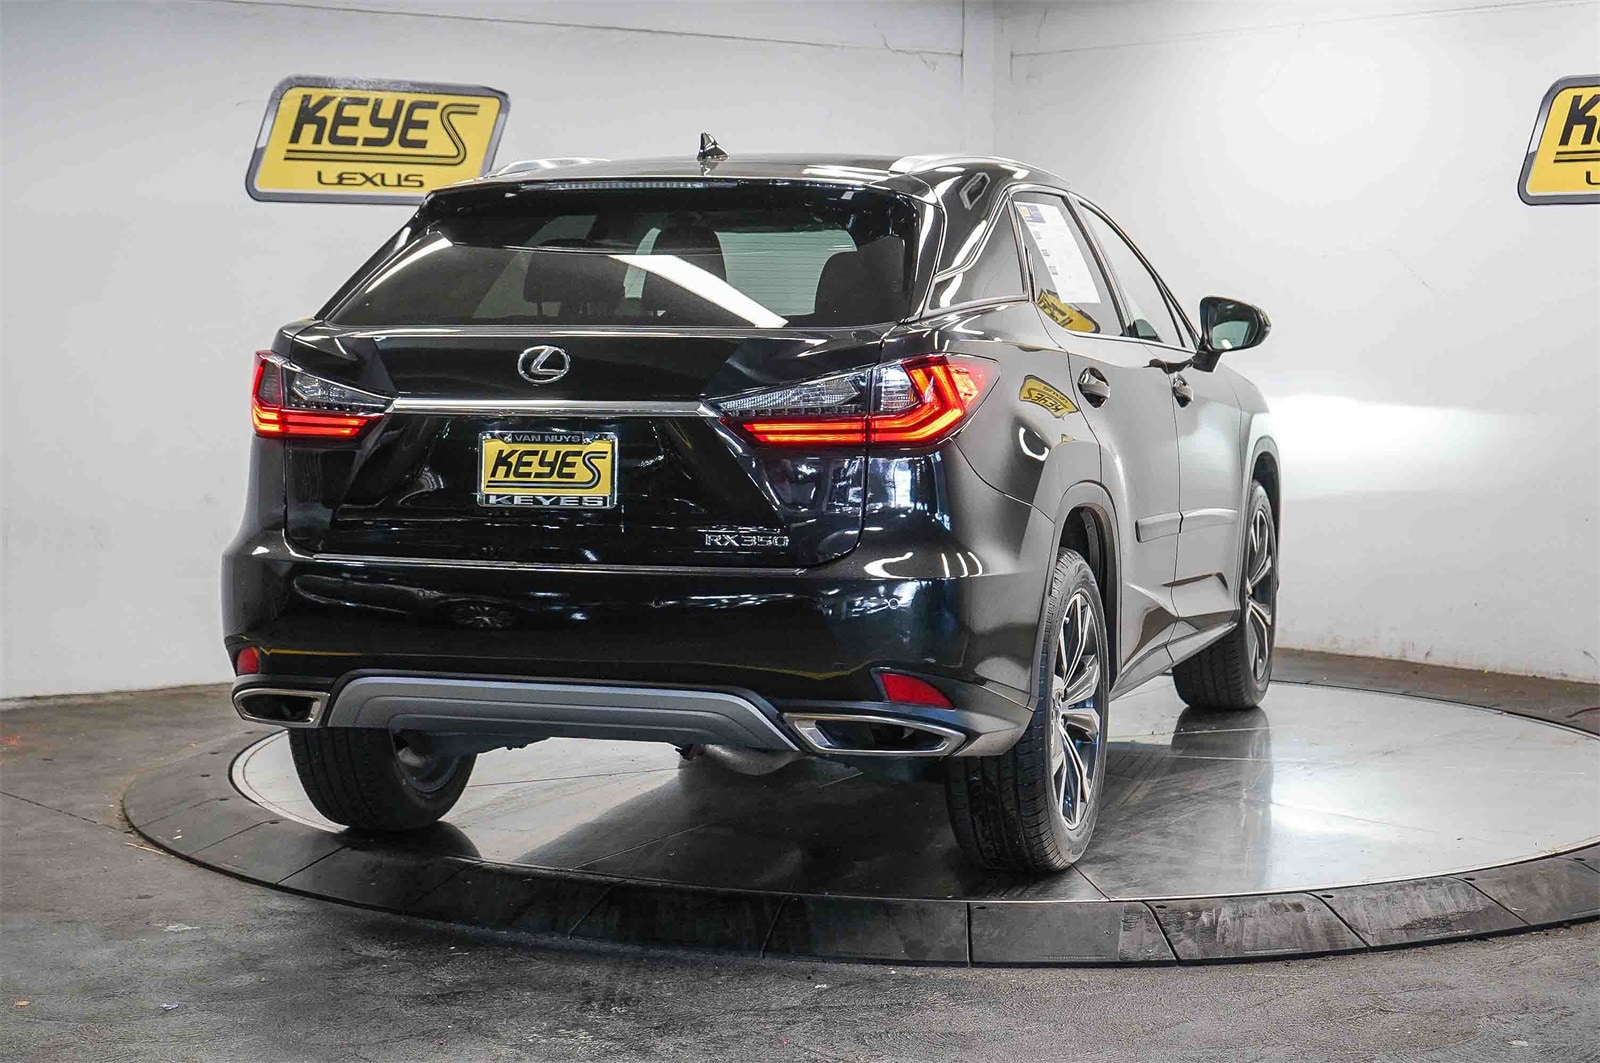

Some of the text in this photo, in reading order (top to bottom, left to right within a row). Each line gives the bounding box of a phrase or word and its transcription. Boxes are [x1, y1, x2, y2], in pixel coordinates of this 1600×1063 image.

[284, 94, 480, 166] KEYES
[1558, 94, 1600, 147] K
[317, 170, 425, 188] LEXUS
[514, 434, 581, 443] VAN NUYS
[486, 450, 608, 489] KEYES
[489, 495, 604, 506] KEYES
